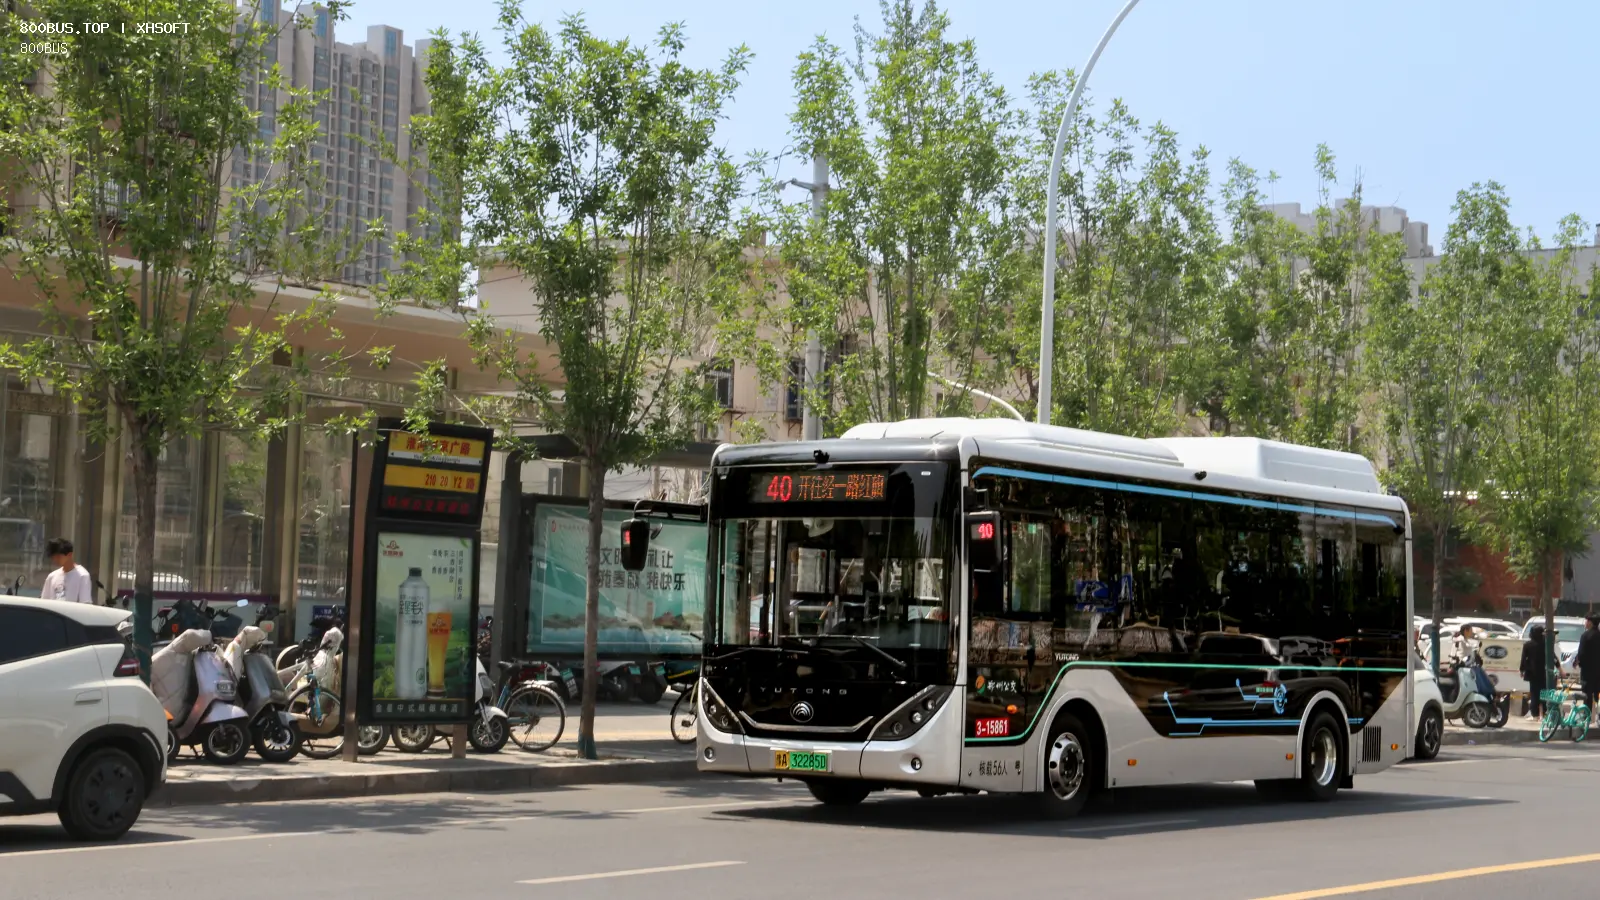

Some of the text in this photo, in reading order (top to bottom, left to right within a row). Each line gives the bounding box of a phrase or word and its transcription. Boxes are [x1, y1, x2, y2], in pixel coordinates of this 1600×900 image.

[766, 475, 793, 501] 40
[1055, 653, 1080, 661] YUTONG
[760, 687, 848, 695] YUTONG
[976, 719, 1008, 736] 3-15861
